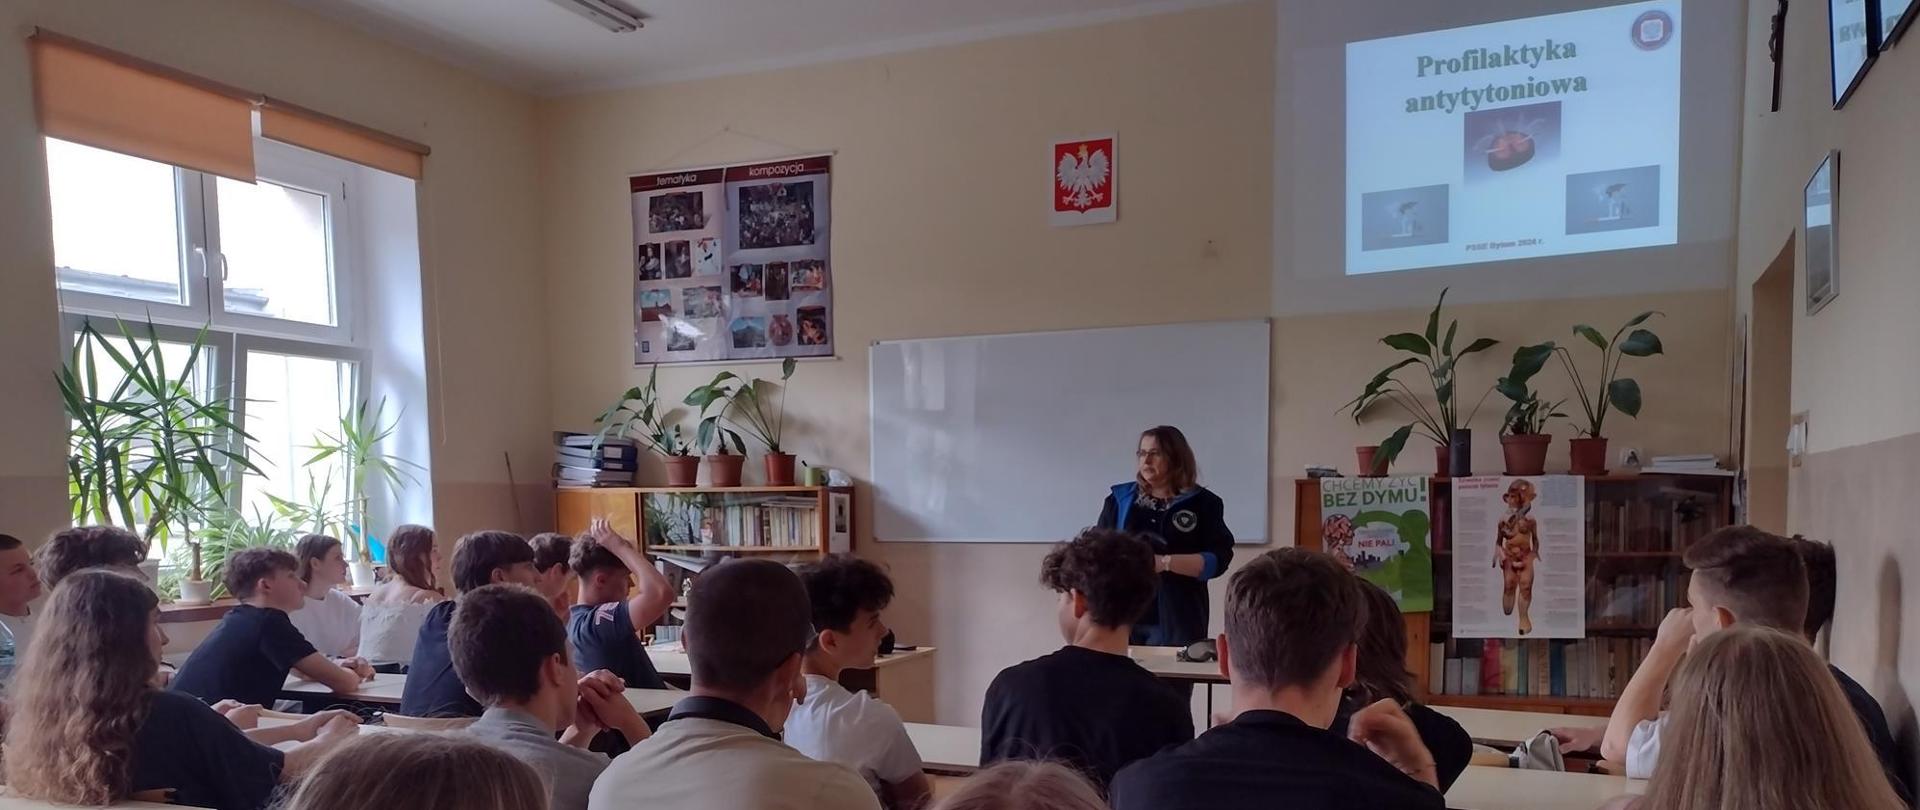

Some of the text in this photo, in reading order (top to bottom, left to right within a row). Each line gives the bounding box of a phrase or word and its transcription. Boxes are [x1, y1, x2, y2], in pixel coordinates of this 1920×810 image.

[1417, 39, 1577, 77] Profilaktyka
[1405, 75, 1588, 114] antytytoniowa
[749, 162, 805, 177] kompozycja
[656, 173, 697, 187] tematyka
[1322, 478, 1384, 493] CHCEMY
[1323, 492, 1358, 508] BEZ
[1358, 539, 1374, 548] NIE
